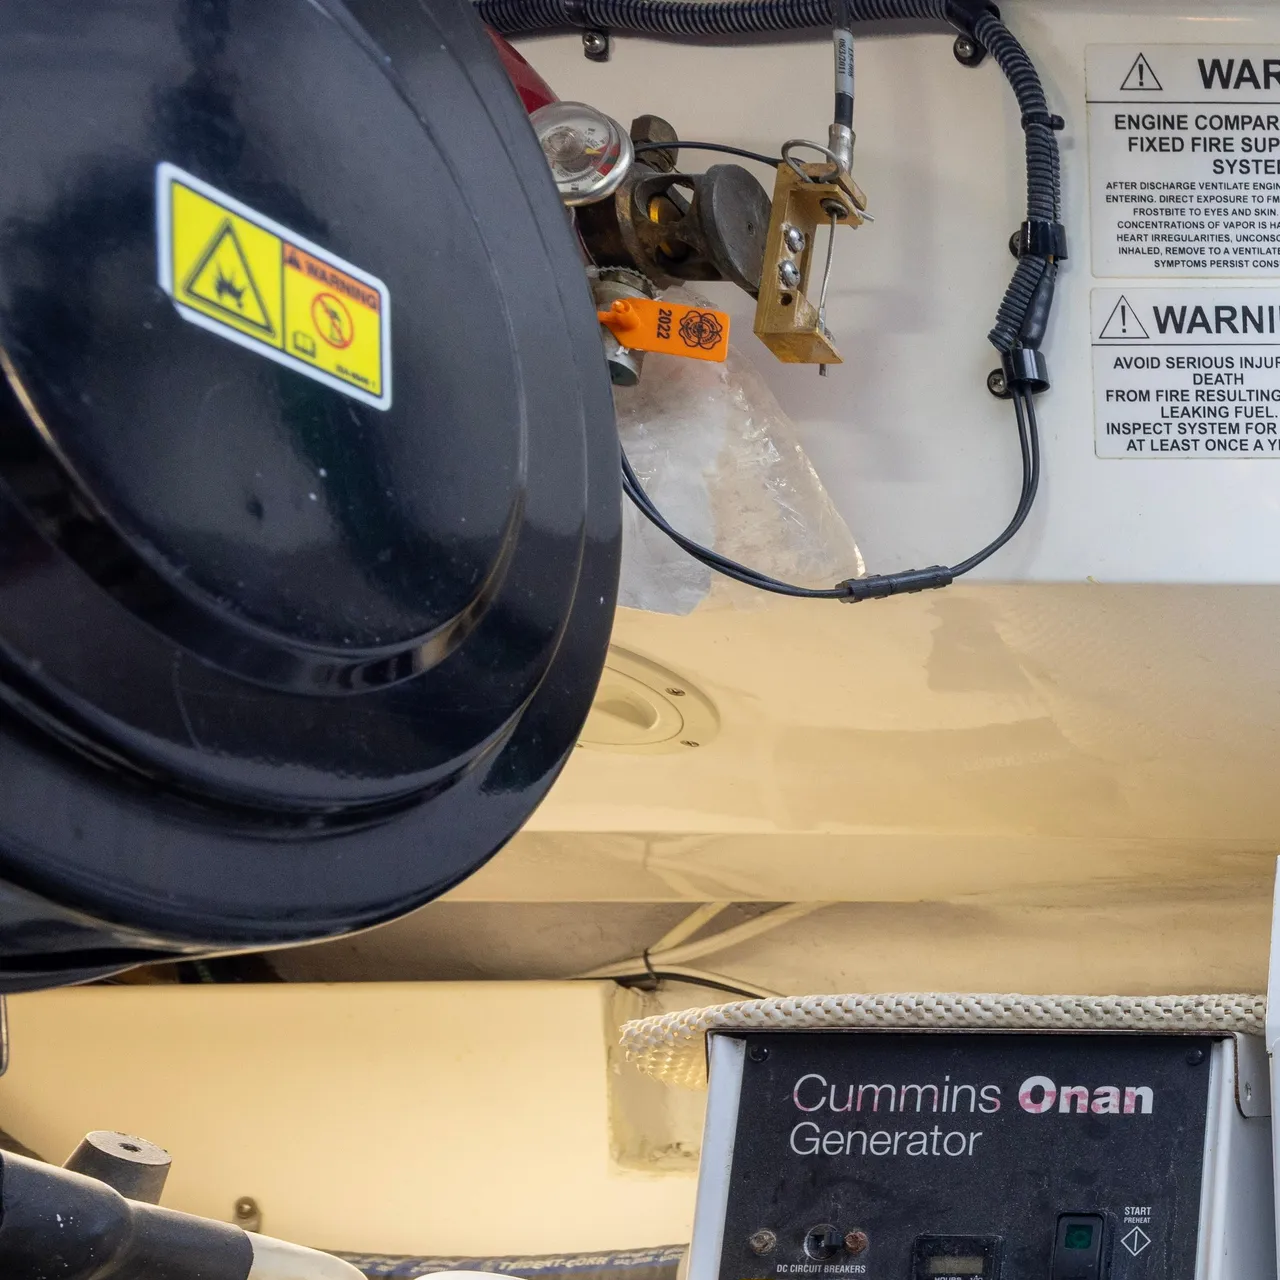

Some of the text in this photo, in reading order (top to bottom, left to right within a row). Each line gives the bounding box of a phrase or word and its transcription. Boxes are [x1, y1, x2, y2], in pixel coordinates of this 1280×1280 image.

[1115, 114, 1188, 130] ENGINE
[1129, 137, 1184, 152] FIXED
[1192, 137, 1234, 152] FIRE
[1106, 182, 1137, 190] AFTER
[1140, 182, 1196, 190] DISCHARGE
[1199, 182, 1249, 190] VENTILATE
[1134, 208, 1185, 216] FROSTBITE
[1189, 208, 1201, 216] TO
[1204, 208, 1228, 216] EYES
[1232, 208, 1251, 216] AND
[1255, 208, 1278, 216] SKIN.
[1154, 260, 1207, 268] SYMPTOMS
[1210, 260, 1249, 268] PERSIST
[305, 260, 378, 309] WARNING
[657, 308, 673, 340] 2022
[1114, 357, 1160, 369] AVOID
[1166, 357, 1234, 369] SERIOUS
[1193, 373, 1243, 385] DEATH
[1106, 390, 1150, 402] FROM
[1156, 390, 1190, 402] FIRE
[1161, 406, 1278, 418] LEAKING FUEL.
[1107, 423, 1172, 434] INSPECT
[1178, 423, 1239, 434] SYSTEM
[1246, 422, 1276, 434] FOR
[1127, 439, 1145, 451] AT
[1151, 439, 1200, 451] LEAST
[1205, 439, 1248, 451] ONCE
[1253, 439, 1264, 450] A
[794, 1074, 1153, 1114] Cummins Onan
[790, 1122, 982, 1156] Generator
[1125, 1207, 1151, 1215] START
[790, 1264, 821, 1272] CIRCUIT
[824, 1265, 866, 1273] BREAKERS
